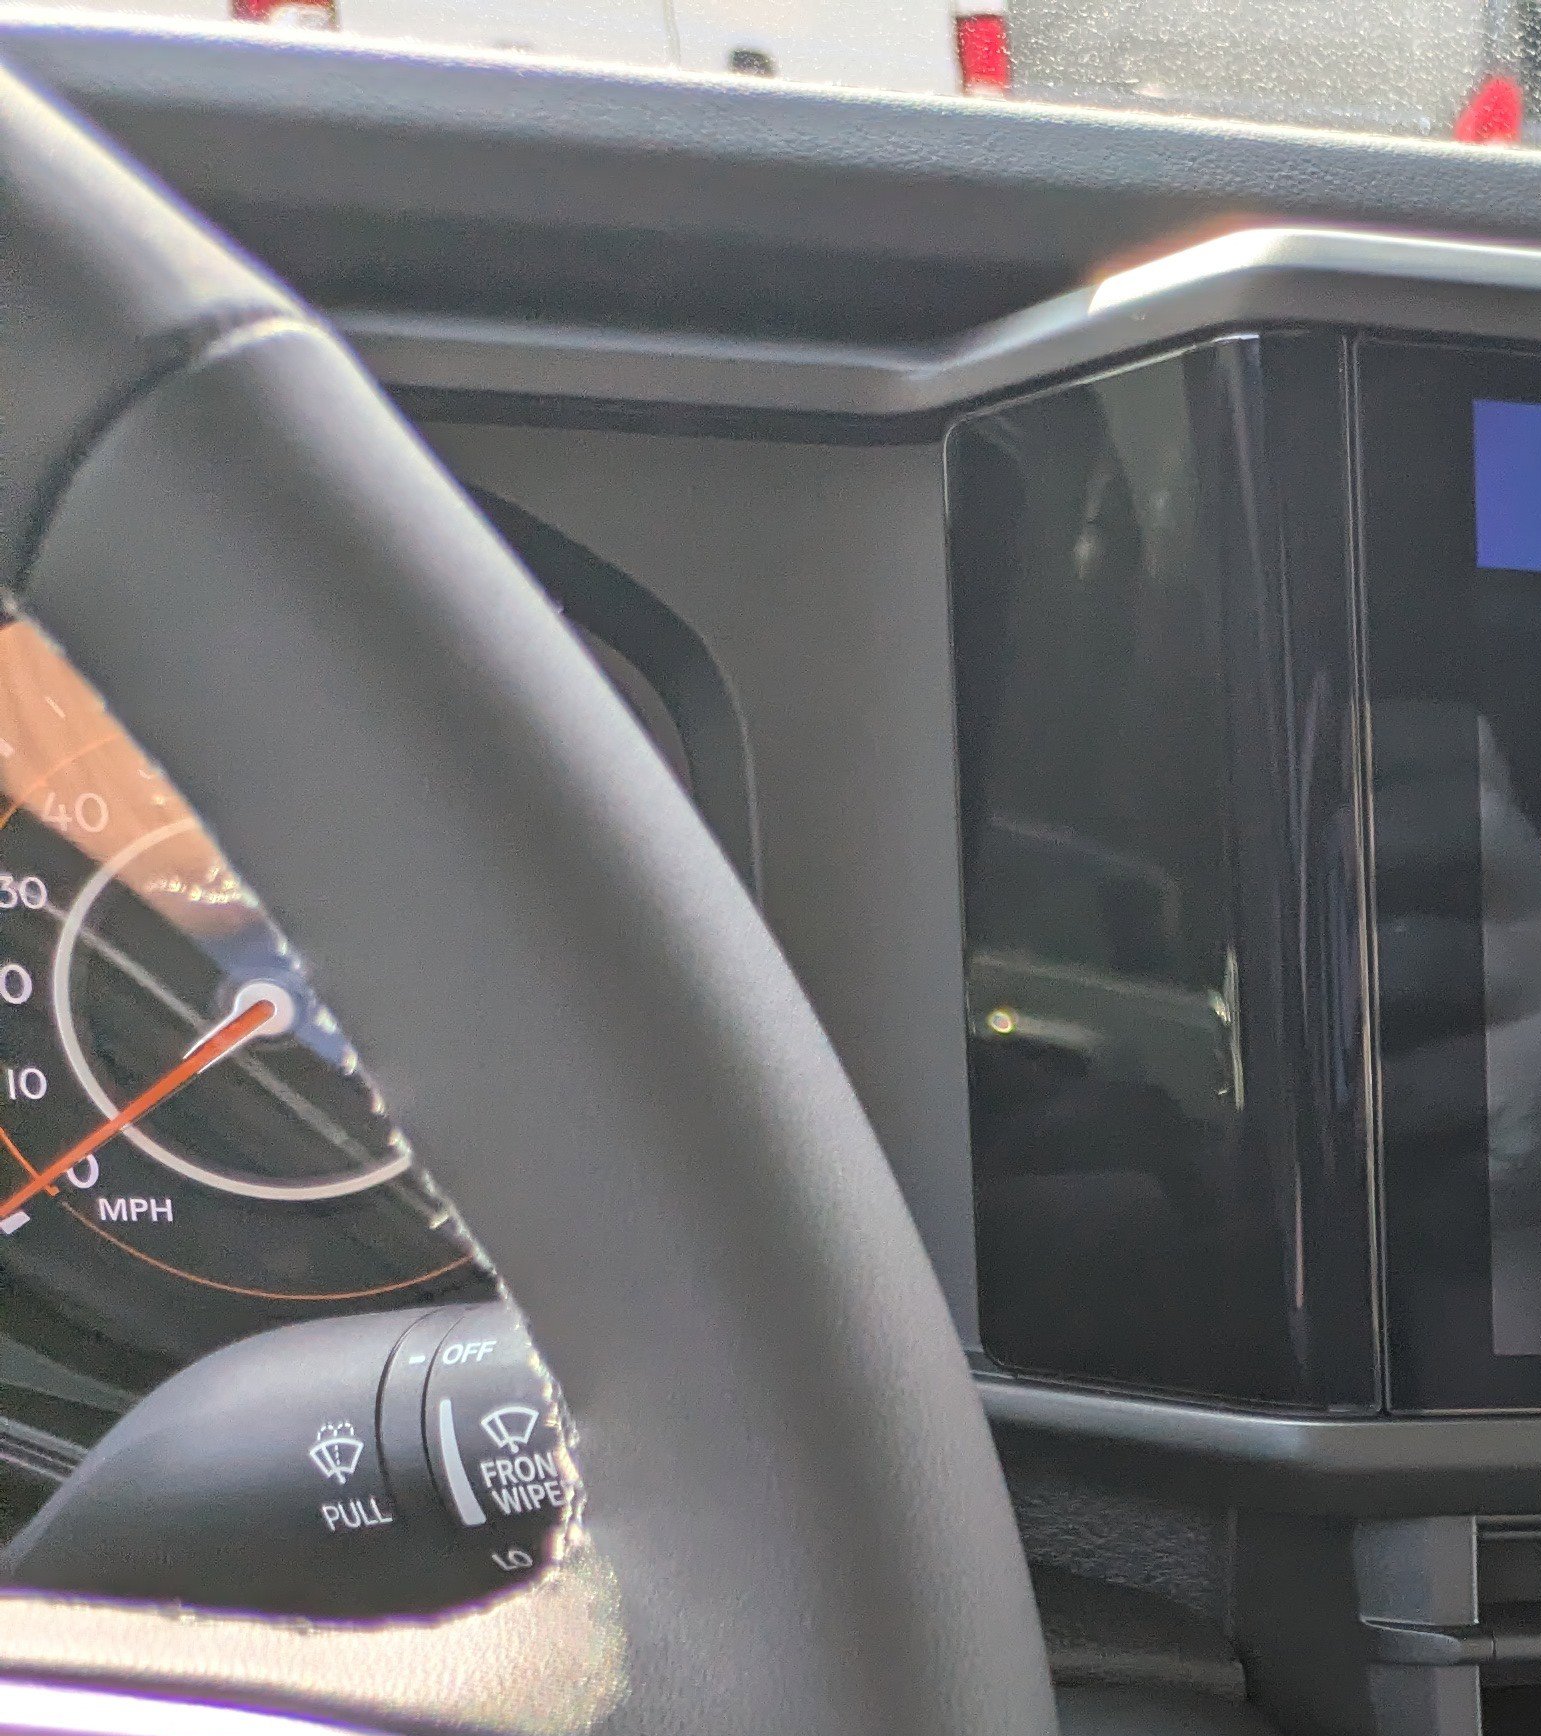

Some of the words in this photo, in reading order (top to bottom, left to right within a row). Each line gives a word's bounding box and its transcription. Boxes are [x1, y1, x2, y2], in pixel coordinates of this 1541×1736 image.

[43, 792, 109, 833] 40
[0, 964, 33, 1004] 0
[7, 1067, 47, 1100] 10
[99, 1198, 173, 1222] MPH
[442, 1340, 497, 1365] OFF
[480, 1451, 558, 1488] FRON
[322, 1497, 393, 1532] PULL
[491, 1480, 564, 1515] WIPE
[491, 1550, 533, 1571] LO
